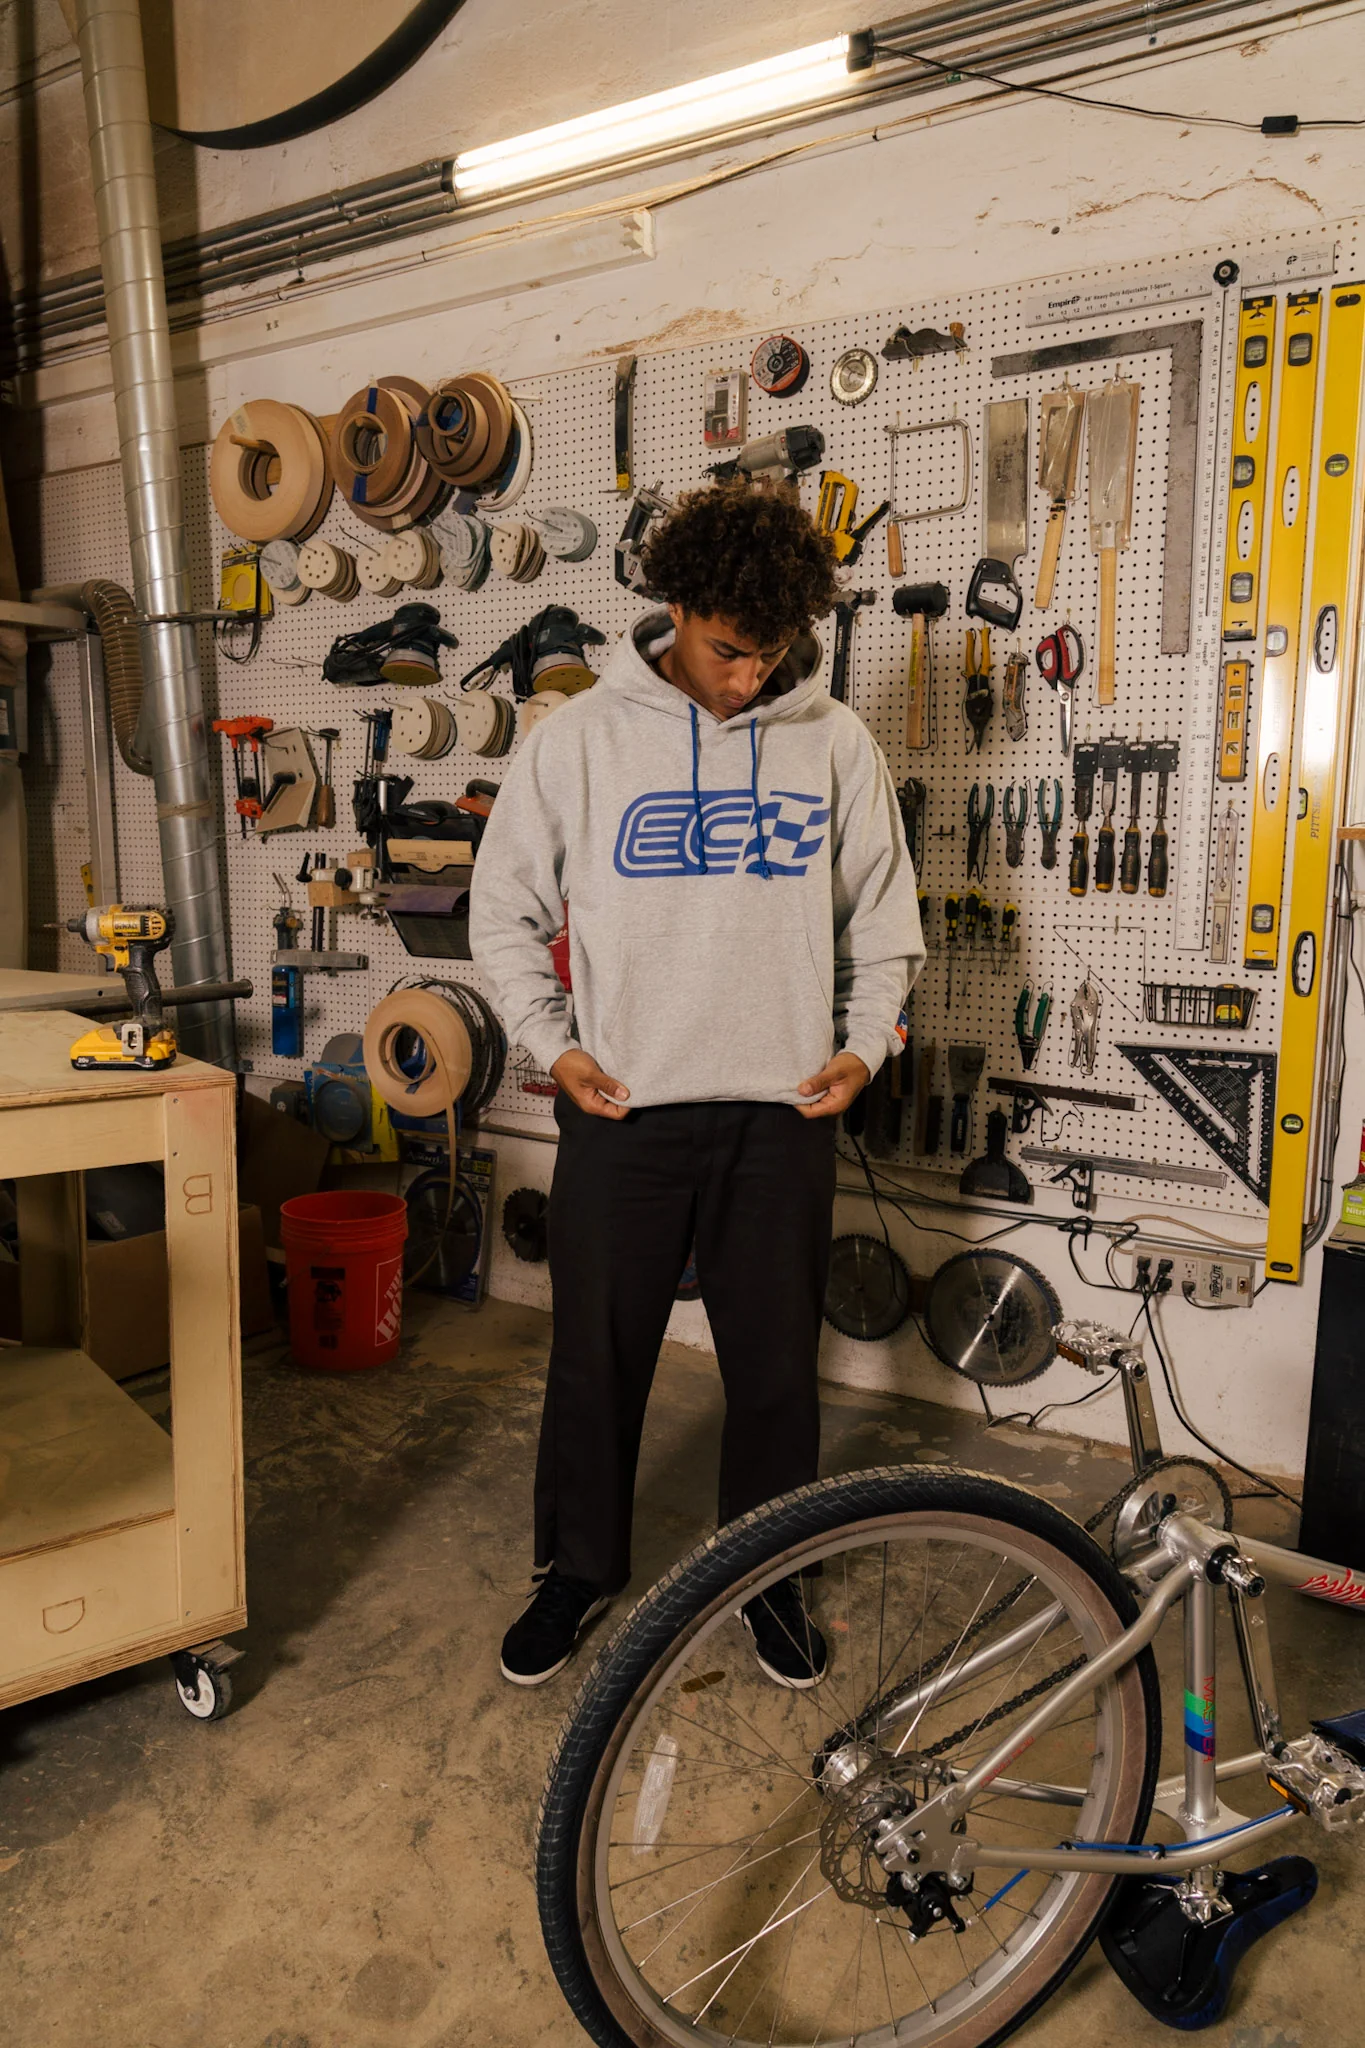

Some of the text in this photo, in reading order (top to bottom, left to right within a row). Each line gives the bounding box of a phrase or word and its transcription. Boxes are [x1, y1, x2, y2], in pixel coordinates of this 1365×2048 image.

[1048, 297, 1076, 310] Empire
[1122, 287, 1148, 297] Adjustable
[1149, 281, 1172, 292] T-Square
[183, 1173, 212, 1215] B
[43, 1597, 86, 1635] D
